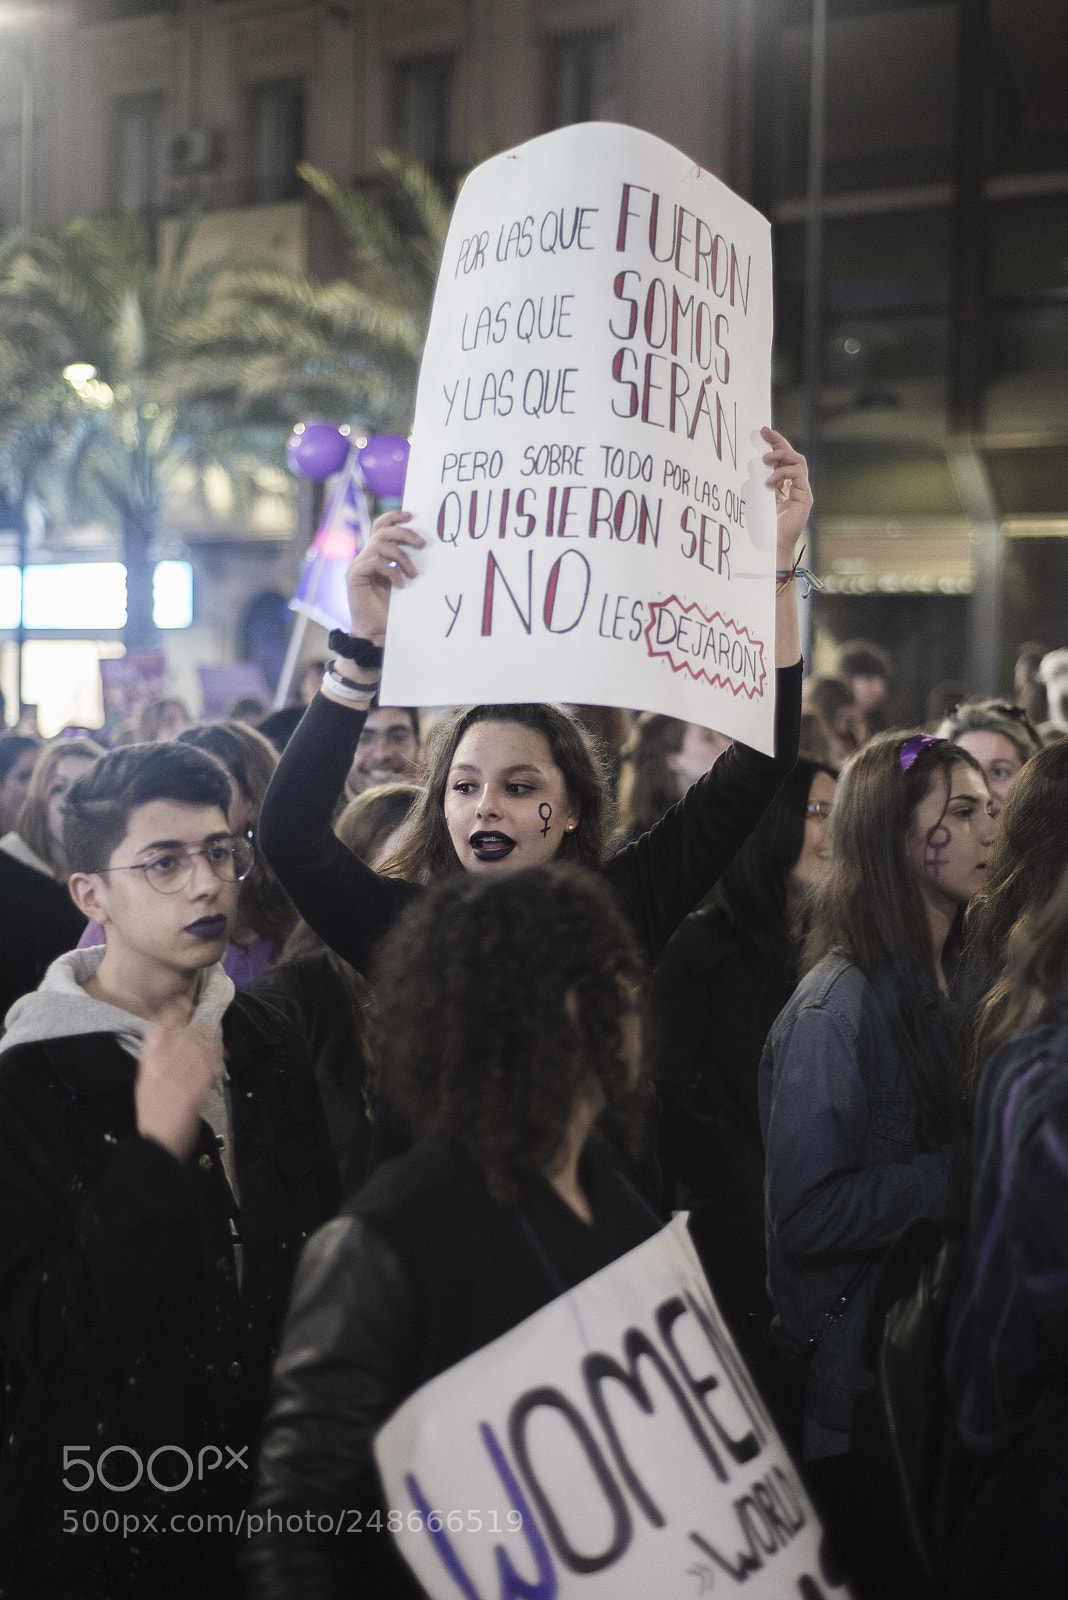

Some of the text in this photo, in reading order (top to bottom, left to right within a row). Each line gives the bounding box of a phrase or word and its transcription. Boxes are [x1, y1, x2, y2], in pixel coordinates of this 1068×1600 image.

[454, 182, 751, 316] POR LAS QUE FUERON
[461, 269, 730, 385] LAS QUE SOMOS
[443, 346, 737, 470] Y LAS QUE SERÁN
[436, 485, 731, 580] QUISIERON SER
[441, 443, 746, 528] PERO SOBRE TODO POR LAS QUE
[480, 548, 591, 637] NO
[598, 593, 644, 641] LES
[656, 607, 757, 682] DEJARON
